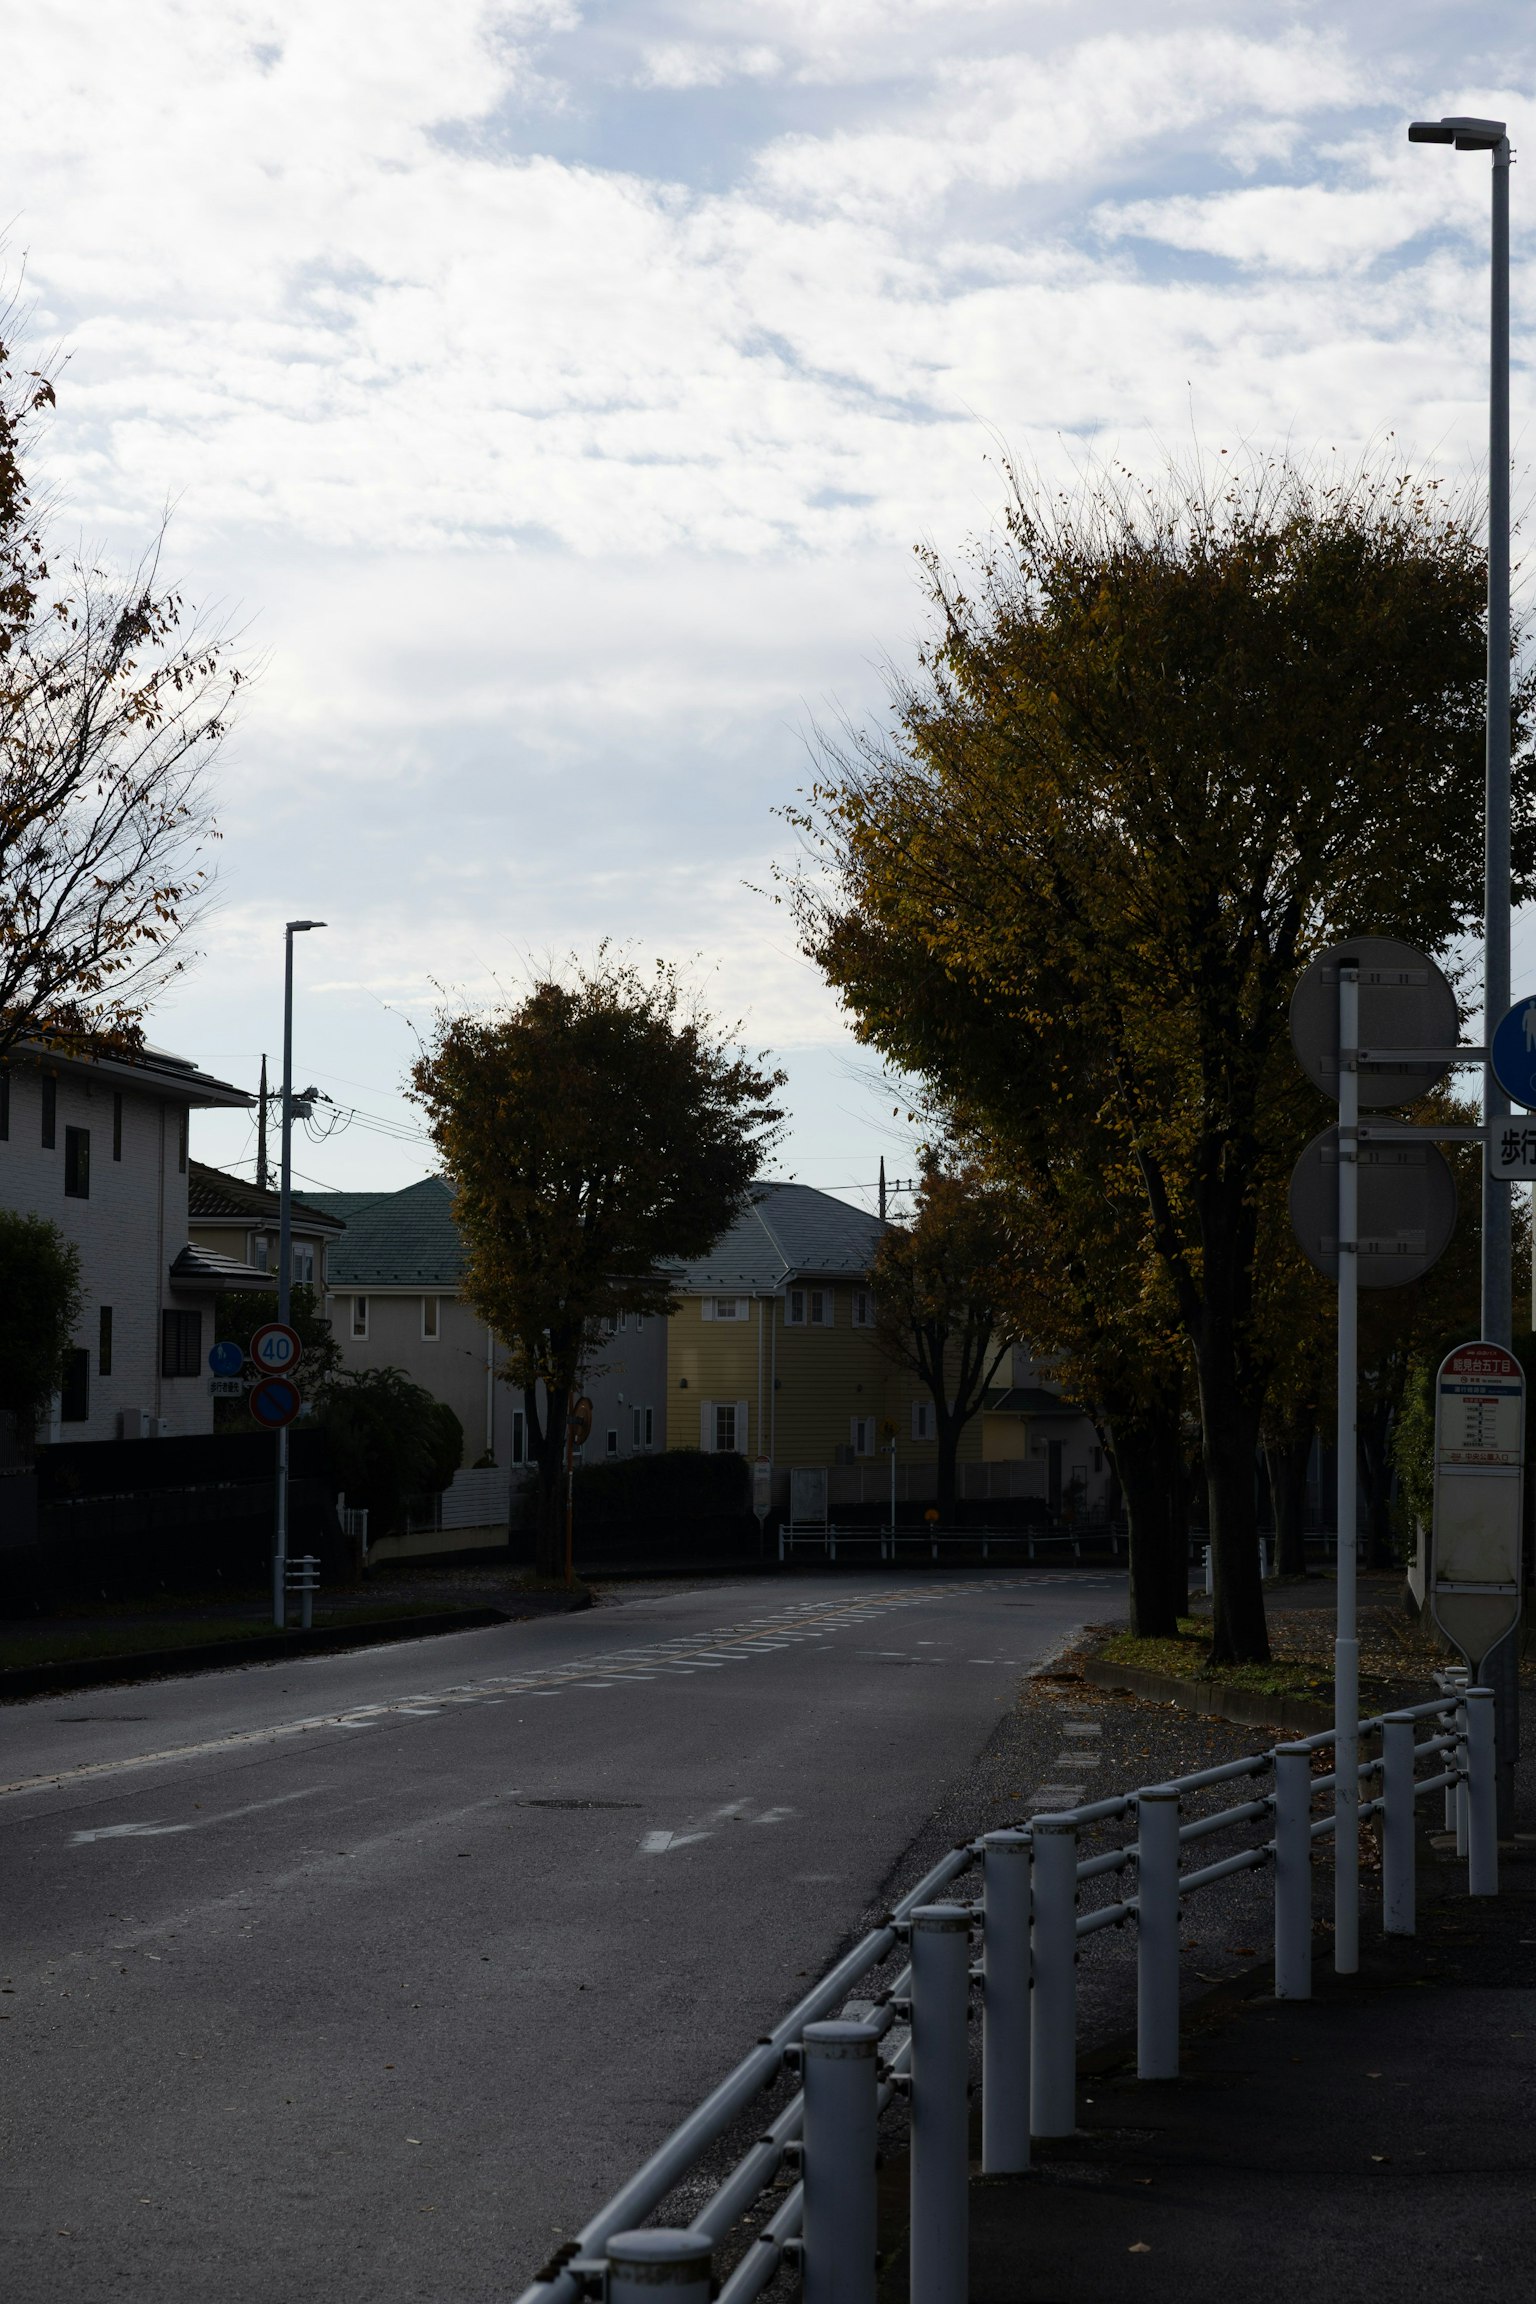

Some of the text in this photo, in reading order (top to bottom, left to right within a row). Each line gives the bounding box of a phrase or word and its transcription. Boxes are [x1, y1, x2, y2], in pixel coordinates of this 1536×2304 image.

[1501, 1128, 1536, 1165] 歩行
[262, 1338, 289, 1360] 40
[1453, 1358, 1511, 1373] 能見台五丁目
